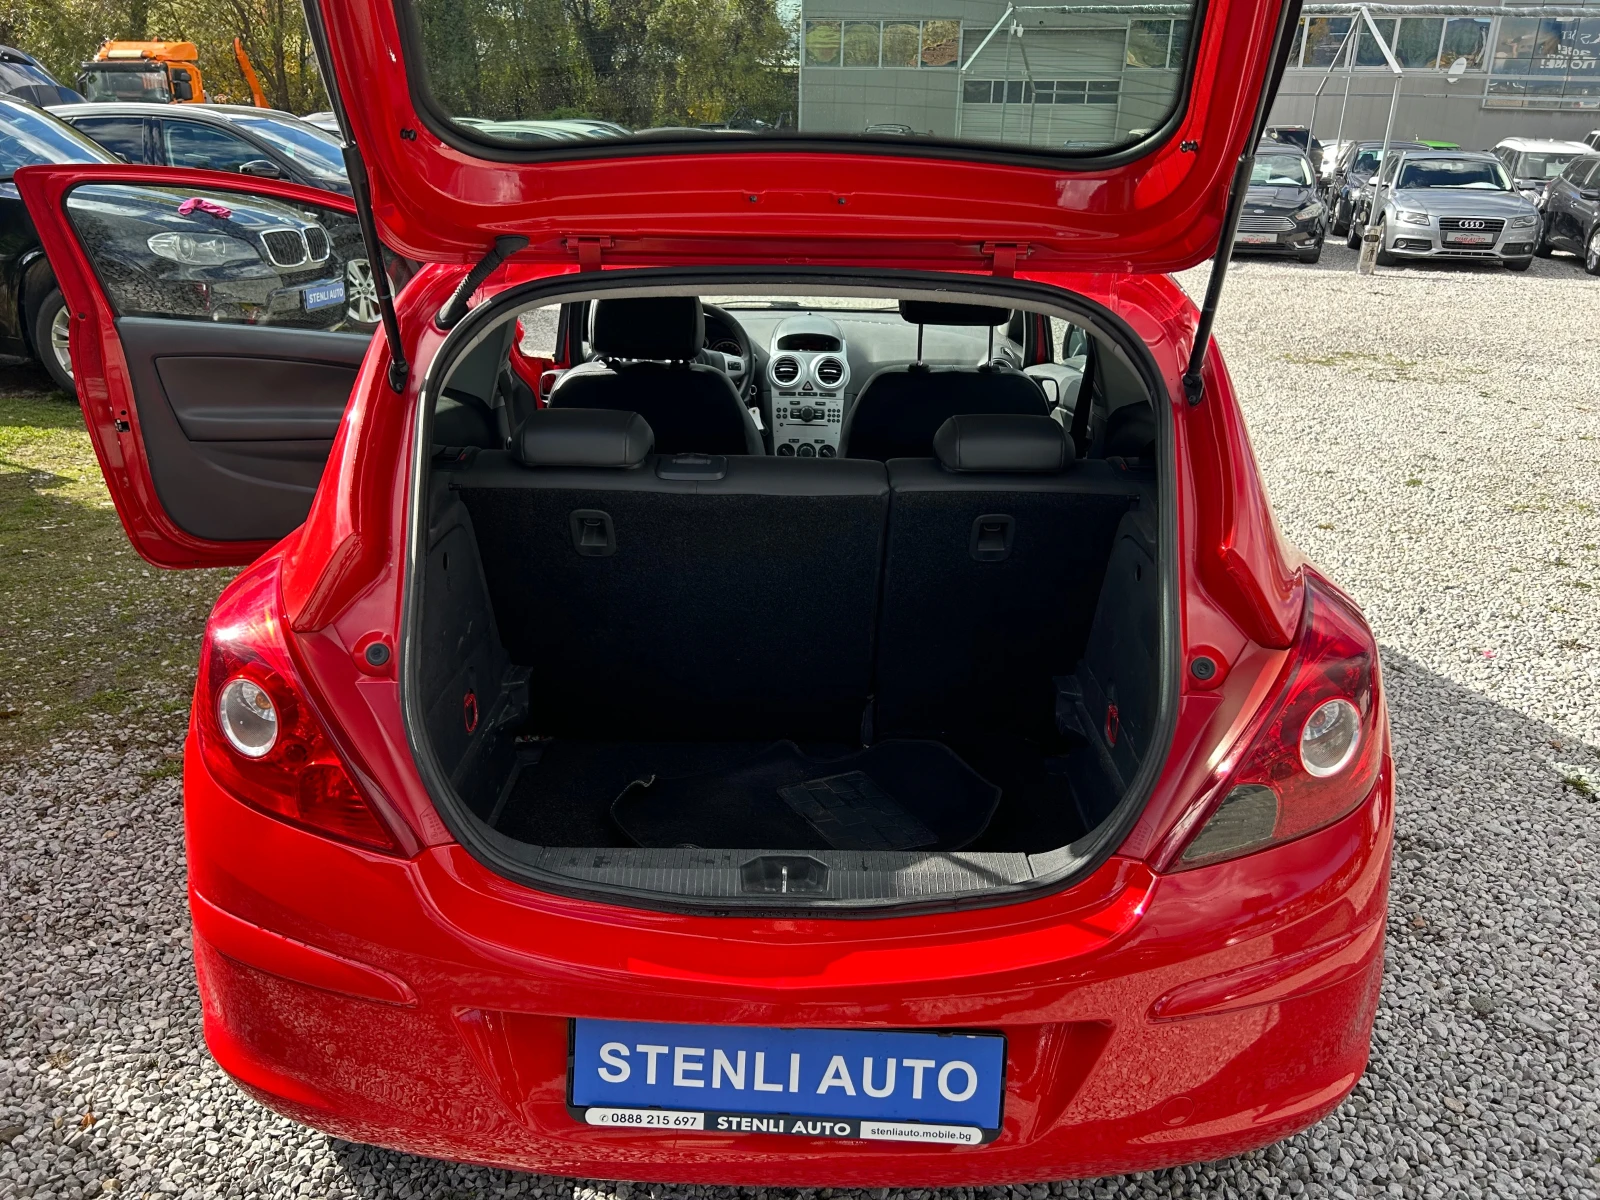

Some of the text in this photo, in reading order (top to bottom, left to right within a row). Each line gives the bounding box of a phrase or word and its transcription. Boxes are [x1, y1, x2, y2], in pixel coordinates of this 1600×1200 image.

[309, 287, 343, 303] STENLI AUTO
[598, 1042, 978, 1102] STENLI AUTO
[611, 1112, 697, 1127] 0888 215 697
[716, 1116, 851, 1136] STENLI AUTO
[870, 1127, 972, 1142] stenliauto.mobile.bg
